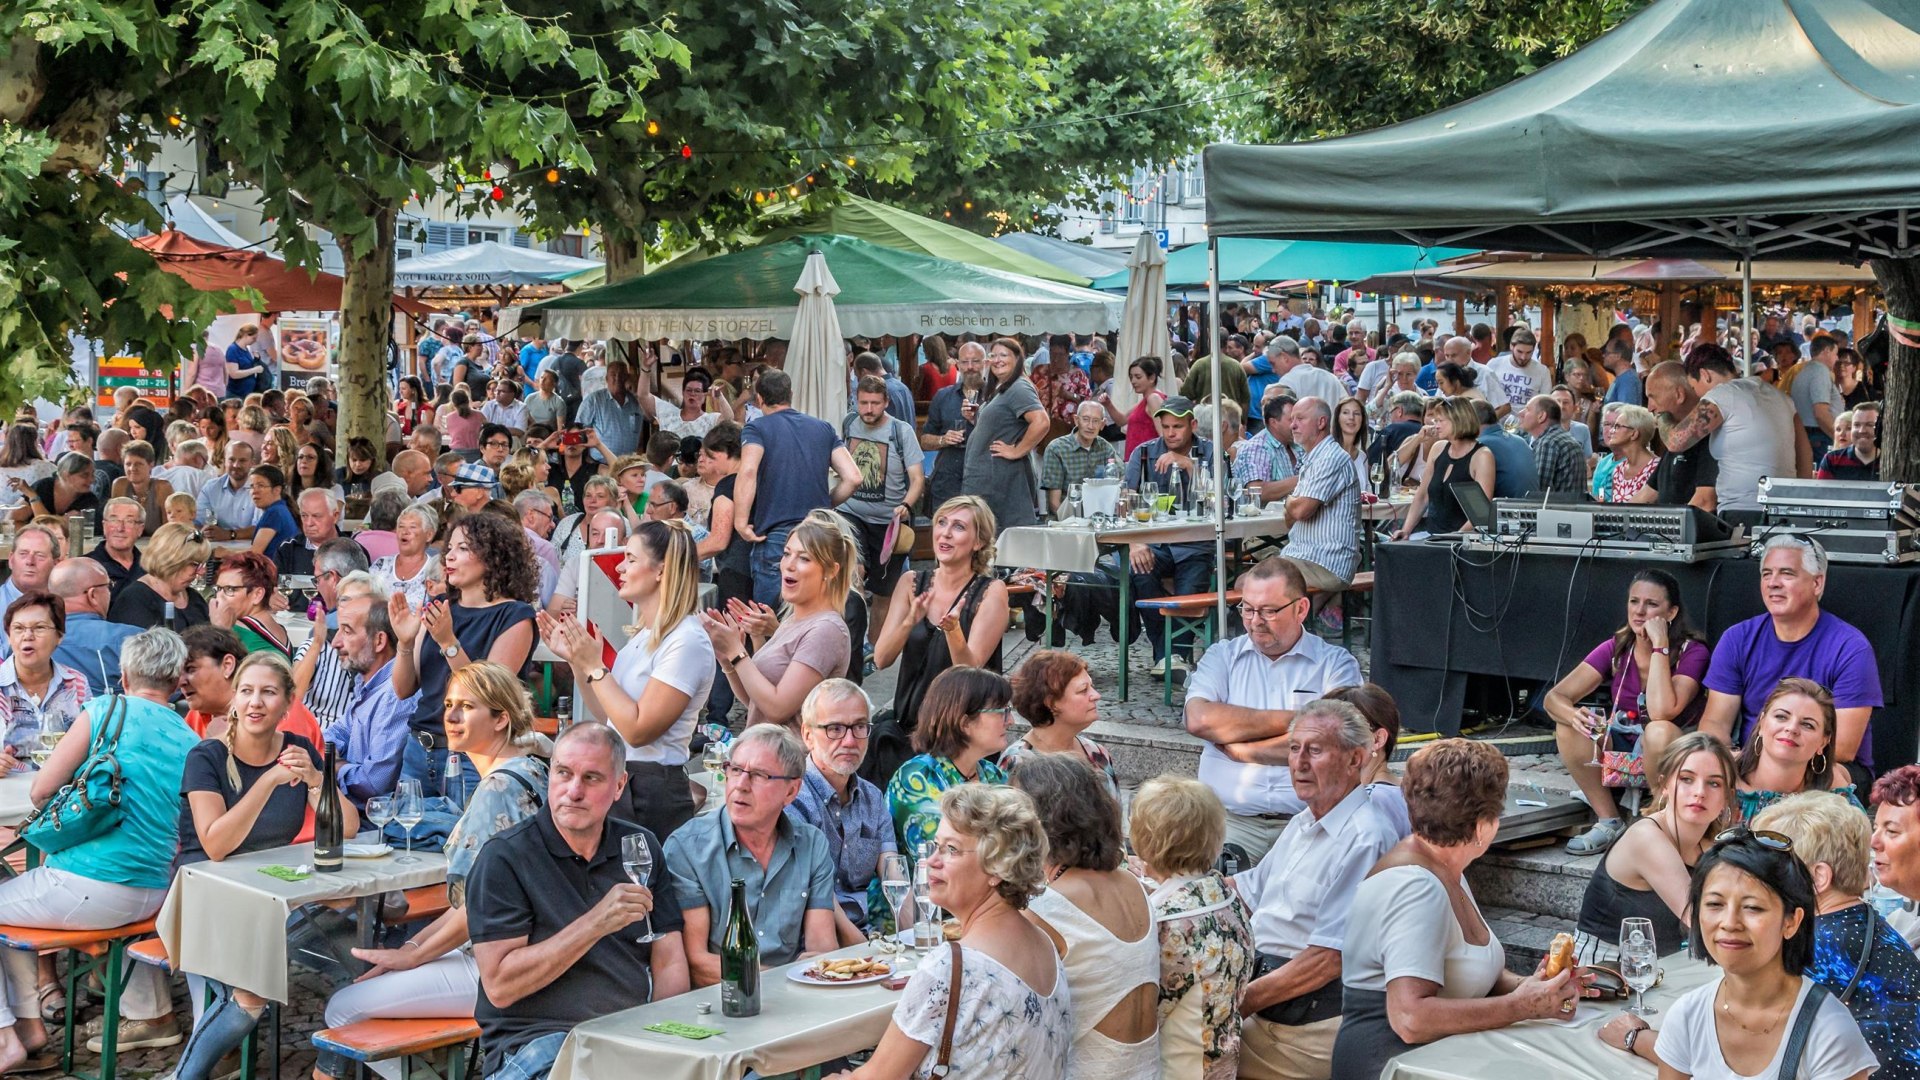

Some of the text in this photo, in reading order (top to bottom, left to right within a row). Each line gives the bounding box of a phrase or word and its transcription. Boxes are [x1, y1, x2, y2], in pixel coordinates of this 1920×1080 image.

[396, 273, 421, 281] NGUT
[455, 273, 462, 281] &
[465, 273, 491, 281] SOHN
[585, 319, 653, 333] WEINGUT
[658, 319, 704, 333] HEINZ
[1013, 314, 1034, 327] Rh.
[136, 378, 148, 386] 201
[289, 376, 308, 387] Bre
[1503, 372, 1532, 386] UNFU
[139, 388, 149, 396] 01
[155, 388, 167, 397] 310
